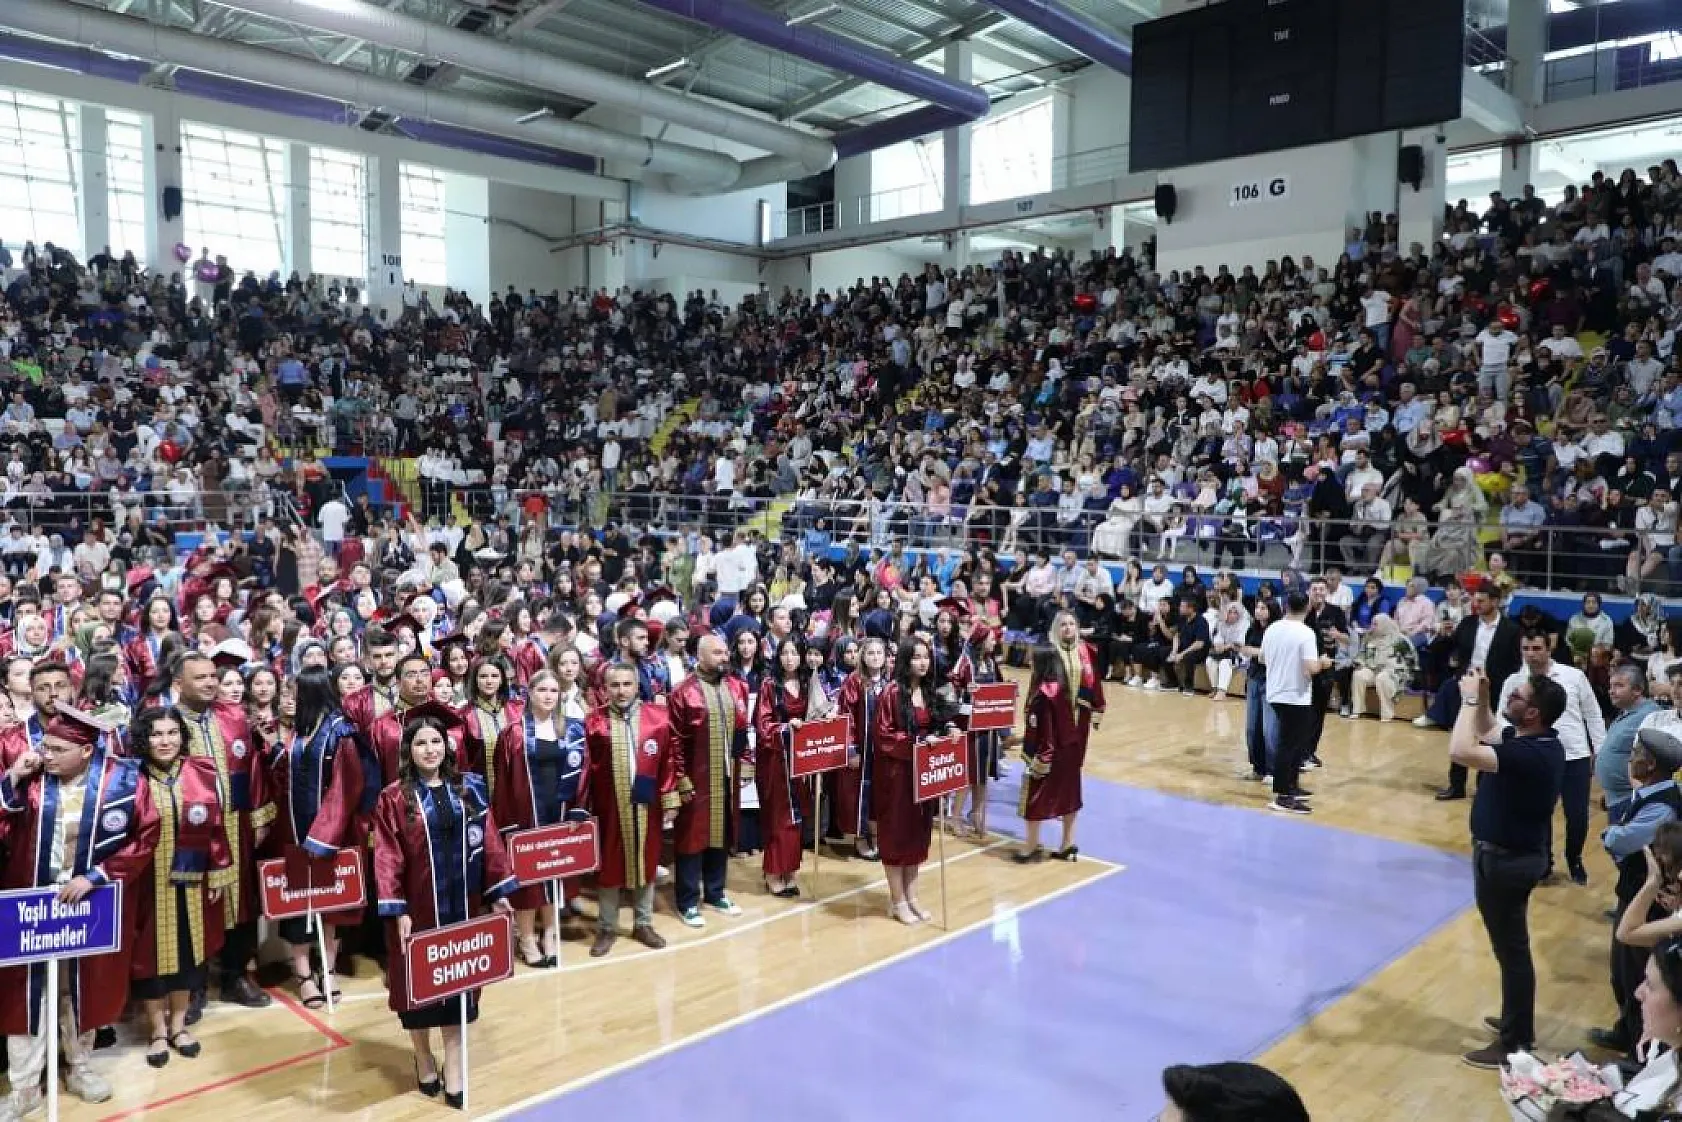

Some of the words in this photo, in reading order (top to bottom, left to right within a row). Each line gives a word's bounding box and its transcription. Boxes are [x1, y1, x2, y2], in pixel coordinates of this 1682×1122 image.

[1234, 183, 1259, 201] 106
[1269, 178, 1285, 196] G
[920, 763, 963, 786] SHMYO
[17, 897, 48, 928] Yaşlı
[20, 923, 87, 952] Hizmetleri
[427, 932, 494, 963] Bolvadin
[433, 955, 491, 986] SHMYO
